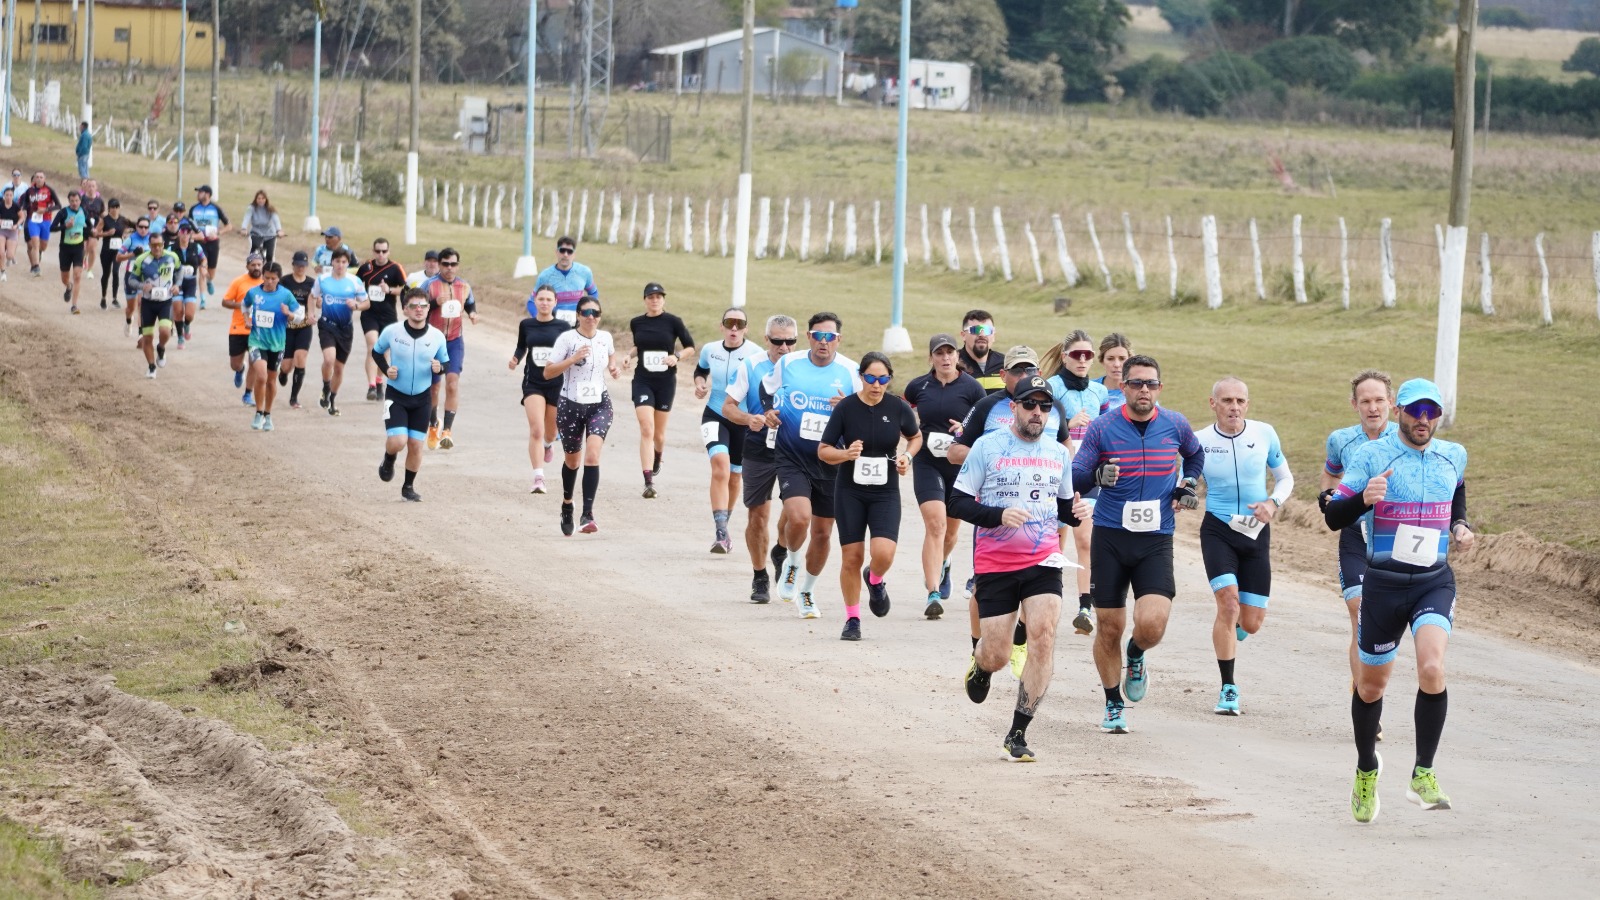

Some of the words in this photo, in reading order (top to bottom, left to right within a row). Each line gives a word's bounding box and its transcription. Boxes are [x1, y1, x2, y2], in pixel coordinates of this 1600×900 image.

[448, 304, 455, 313] 9
[256, 314, 273, 324] 130
[534, 352, 551, 361] 12
[582, 386, 598, 397] 21
[703, 427, 709, 438] 3
[861, 463, 882, 477] 51
[1392, 504, 1433, 515] PALOMO
[1130, 508, 1154, 523] 59
[1412, 534, 1425, 554] 7
